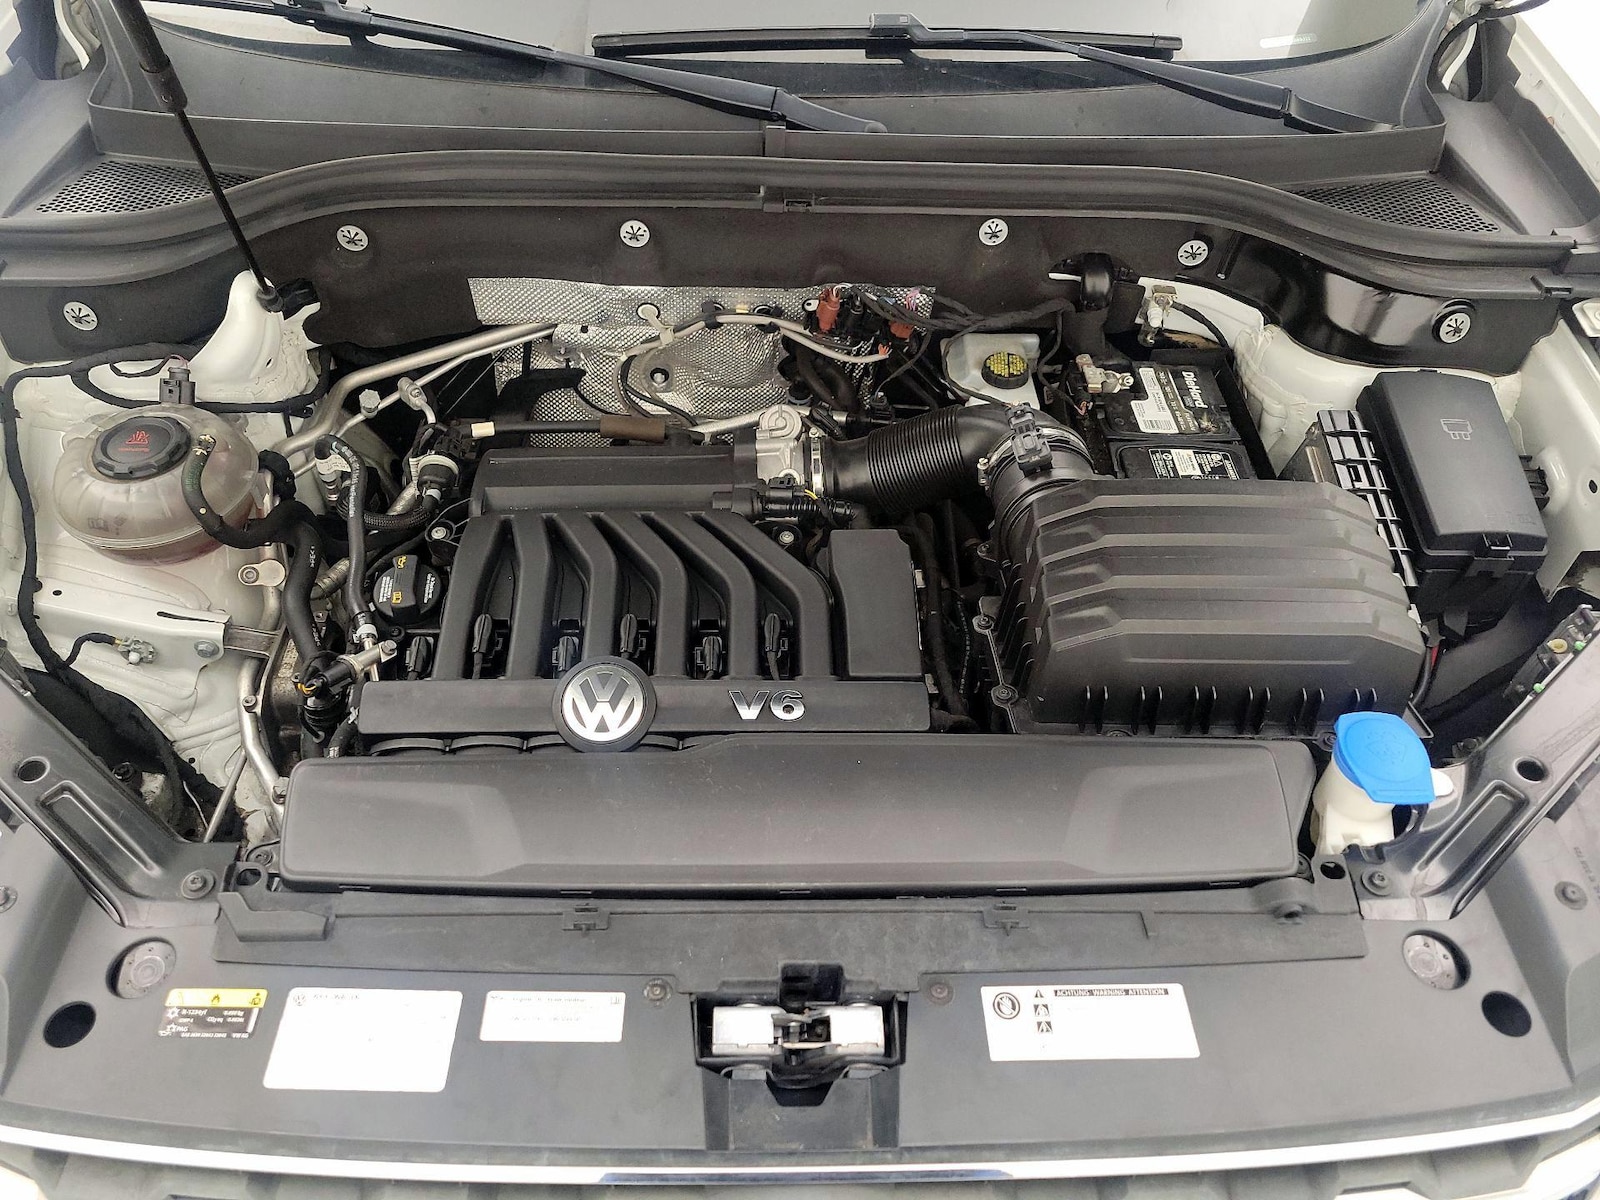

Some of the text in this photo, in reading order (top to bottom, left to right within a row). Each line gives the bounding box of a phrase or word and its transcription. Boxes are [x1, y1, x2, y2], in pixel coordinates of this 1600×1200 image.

[1182, 371, 1208, 408] DieHard
[562, 663, 644, 742] VW
[728, 690, 806, 721] V6
[1057, 989, 1090, 997] ACHTUNG
[1129, 988, 1165, 996] ATTENTION
